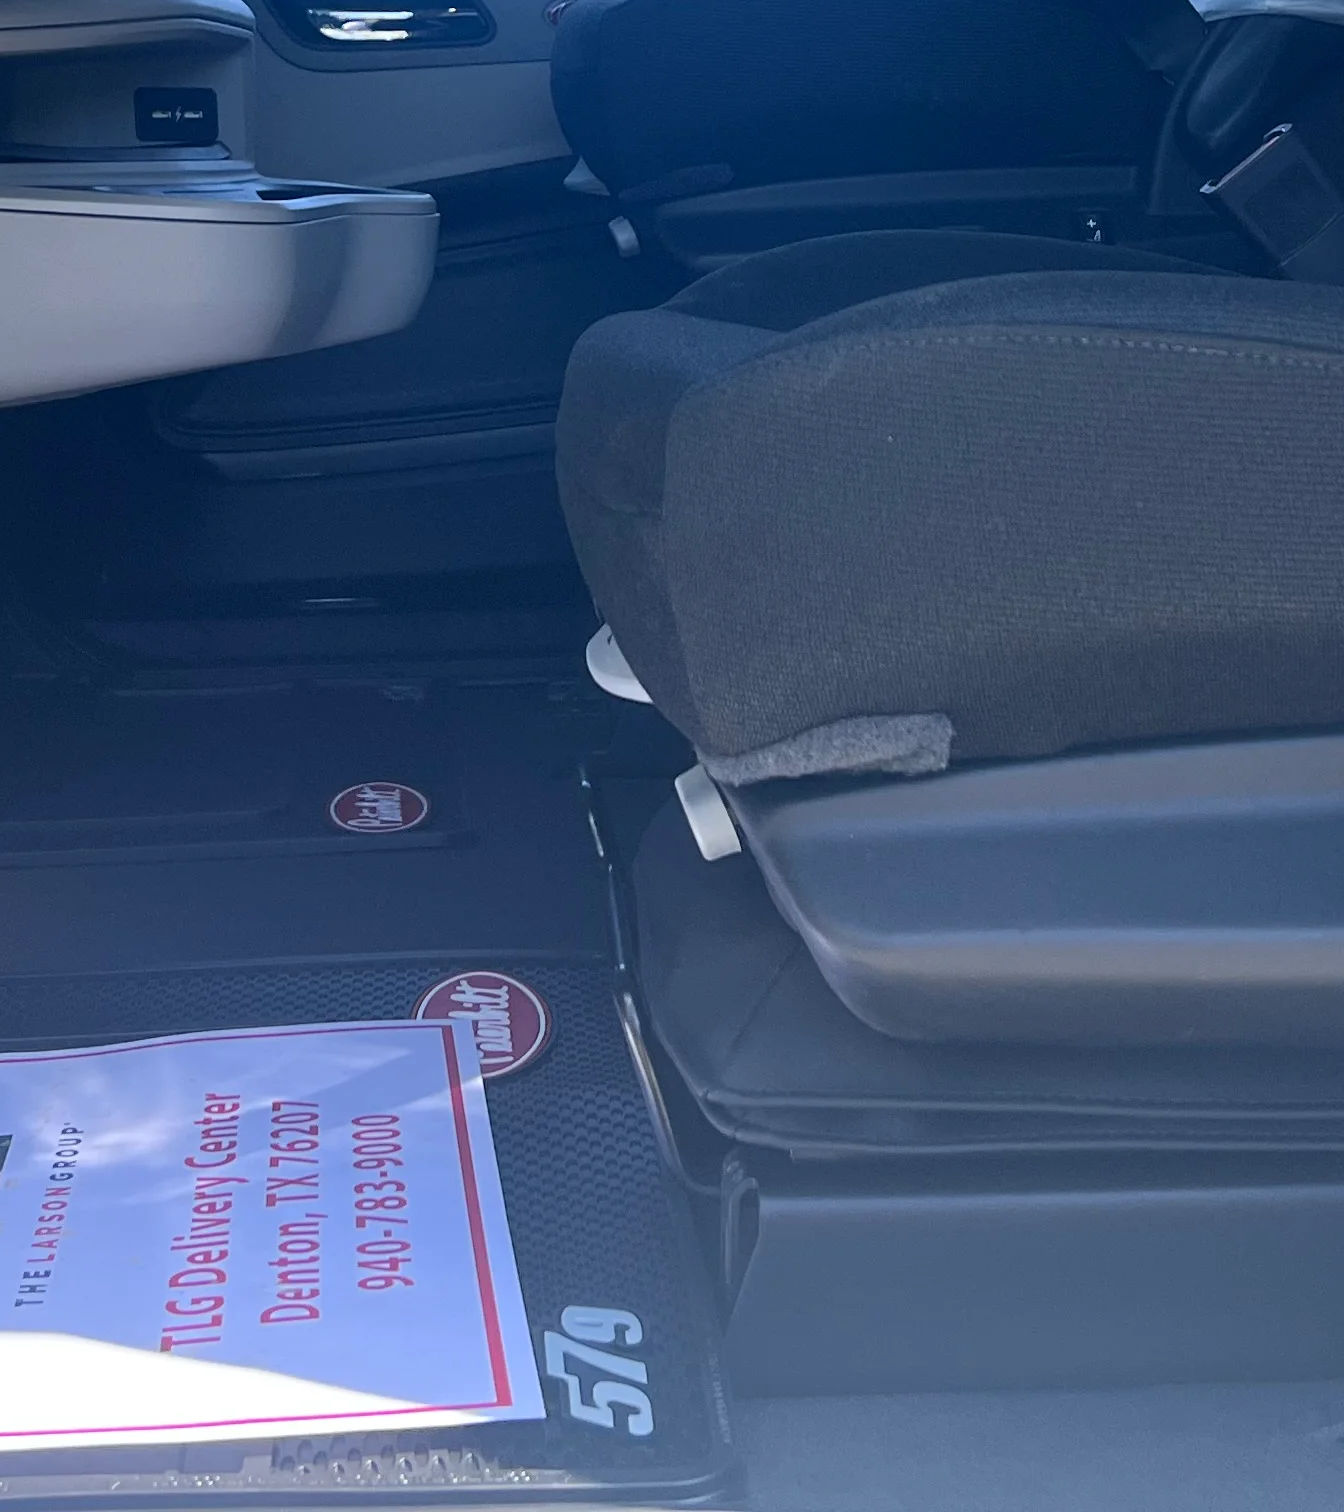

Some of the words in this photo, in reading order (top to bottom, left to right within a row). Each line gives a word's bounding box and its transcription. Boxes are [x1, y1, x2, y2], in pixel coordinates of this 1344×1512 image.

[50, 1125, 84, 1181] GROUP
[184, 1093, 240, 1168] Center
[269, 1101, 319, 1168] 76207
[27, 1188, 72, 1263] LARSON
[266, 1173, 319, 1207] TX
[351, 1114, 414, 1290] 940-783-9000
[168, 1177, 250, 1288] Delivery
[260, 1212, 328, 1324] Denton,
[14, 1270, 52, 1307] THE
[160, 1296, 224, 1352] TLG
[544, 1305, 654, 1436] 579
